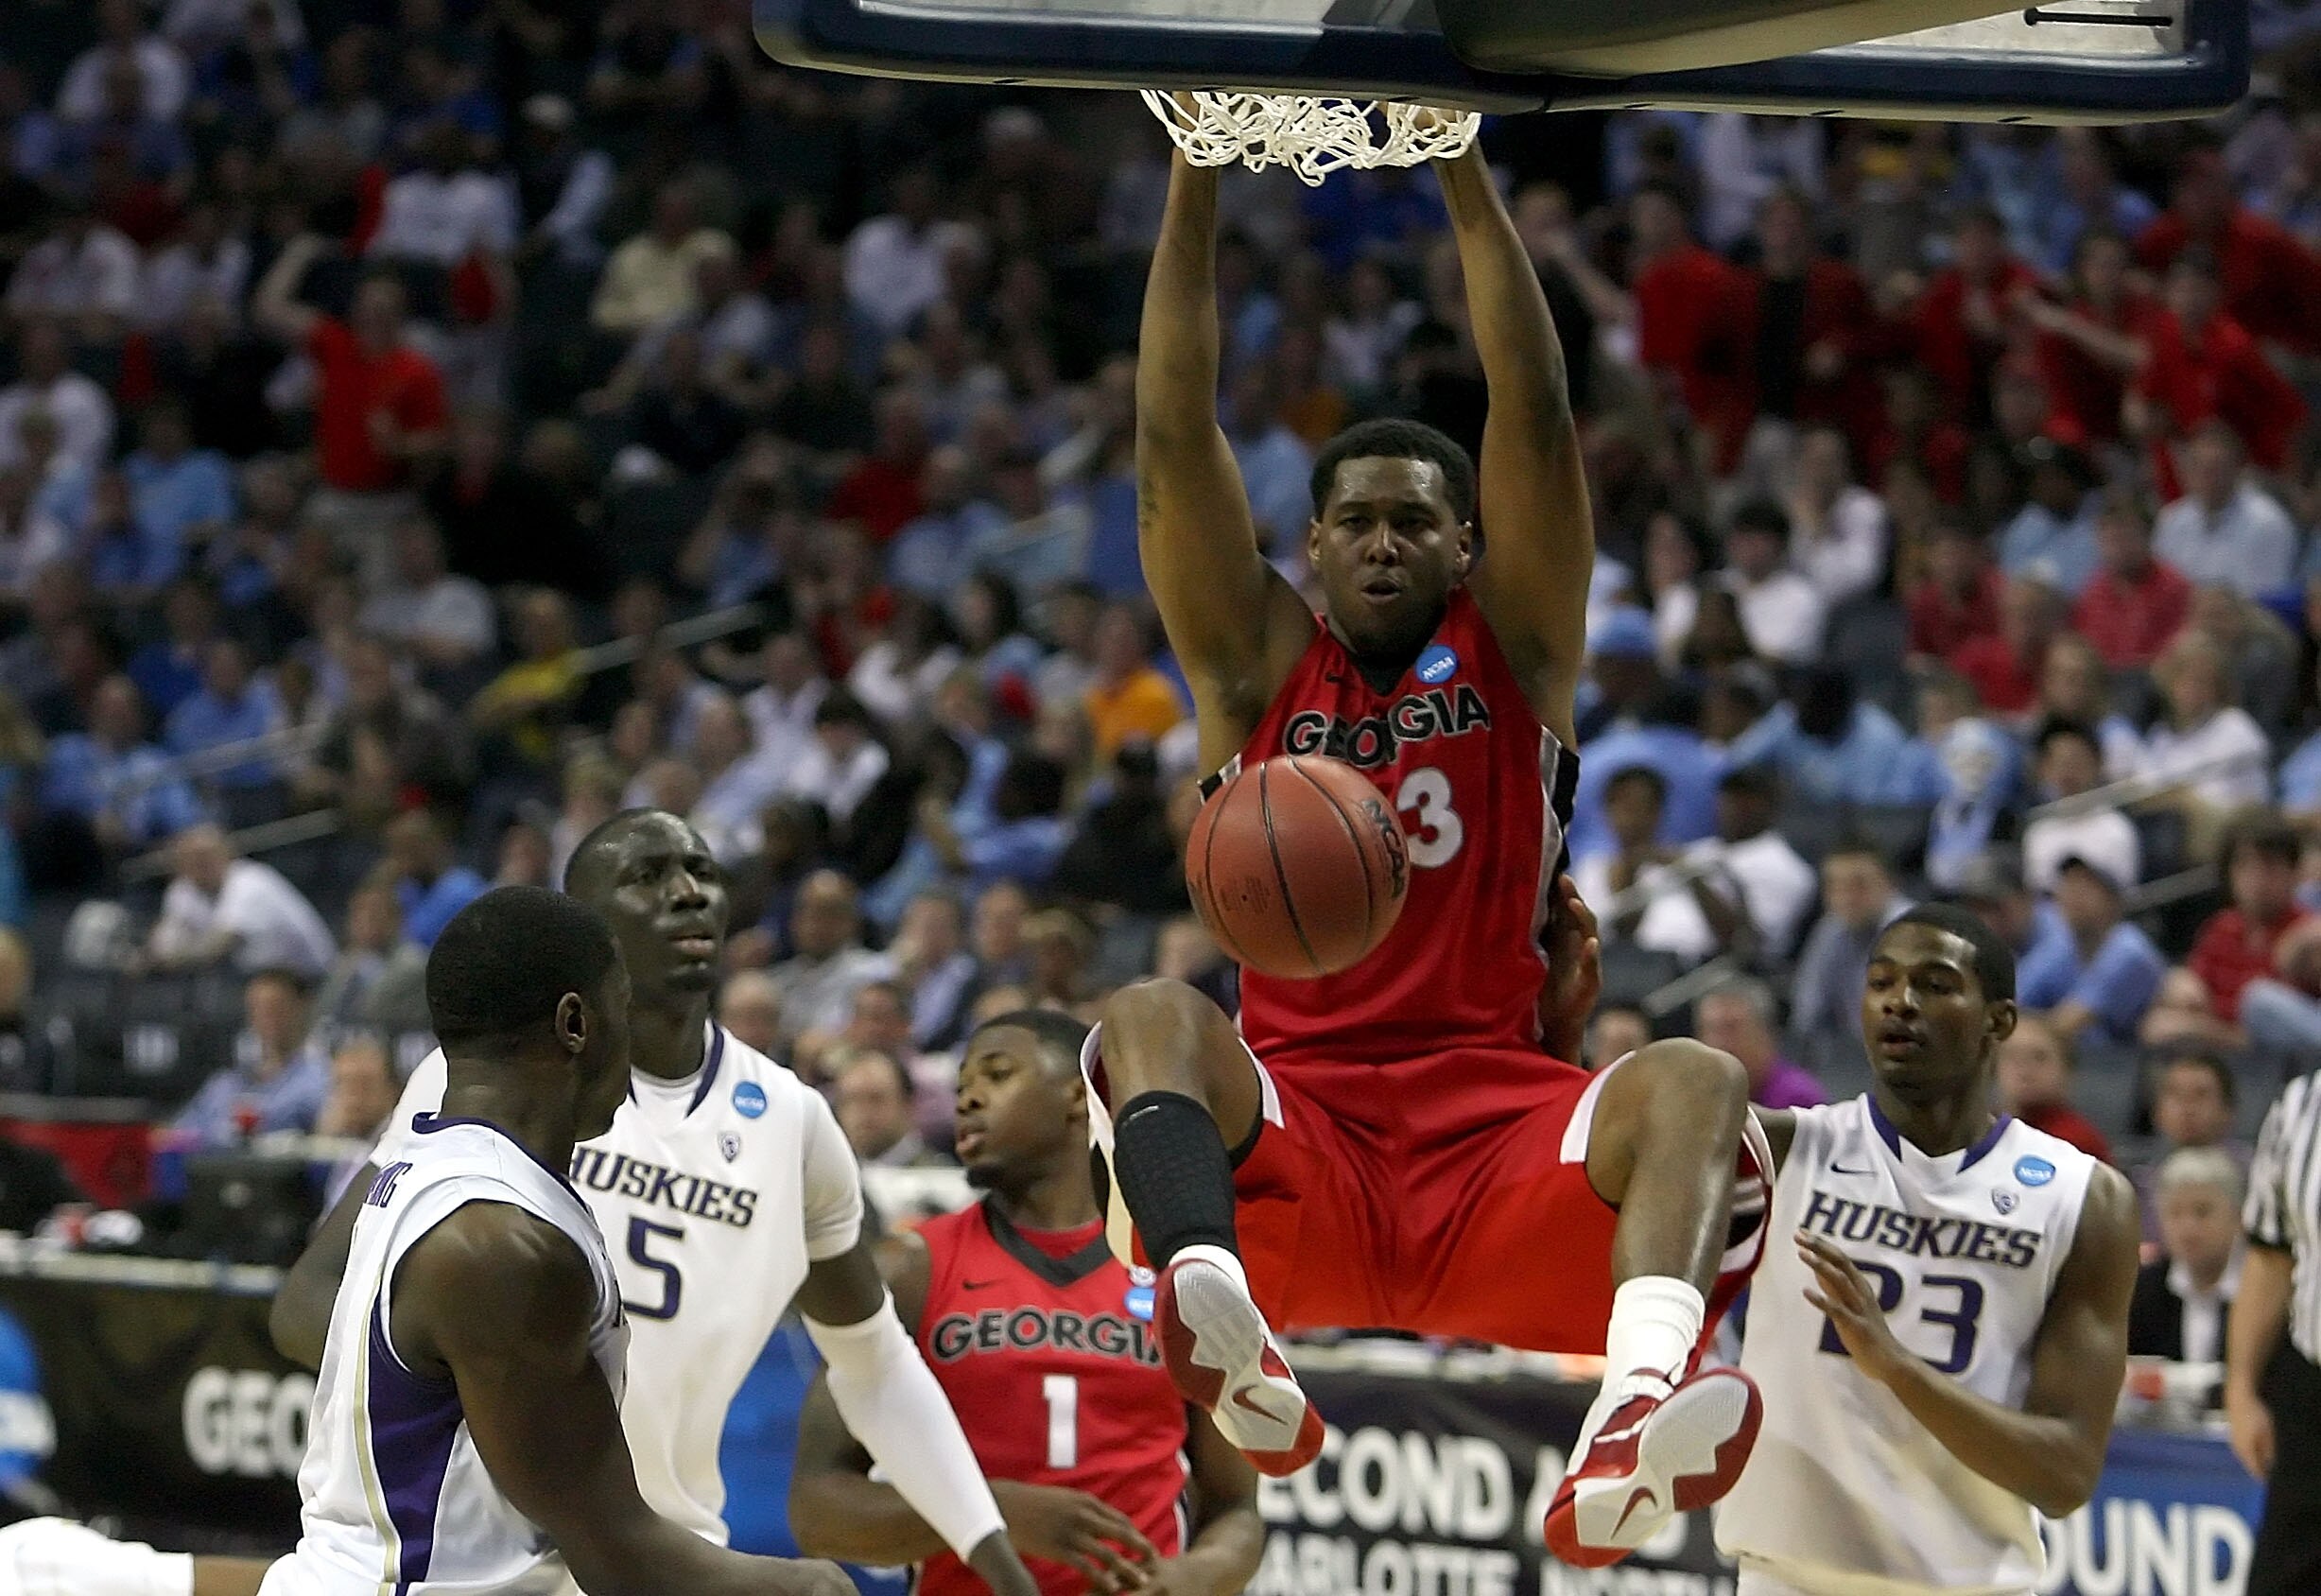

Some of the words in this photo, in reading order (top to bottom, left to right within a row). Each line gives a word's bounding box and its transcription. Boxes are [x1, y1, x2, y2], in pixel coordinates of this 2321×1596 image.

[619, 1215, 684, 1320] 5
[1800, 1190, 2041, 1269] HUSKIES
[1043, 1374, 1078, 1468] 1
